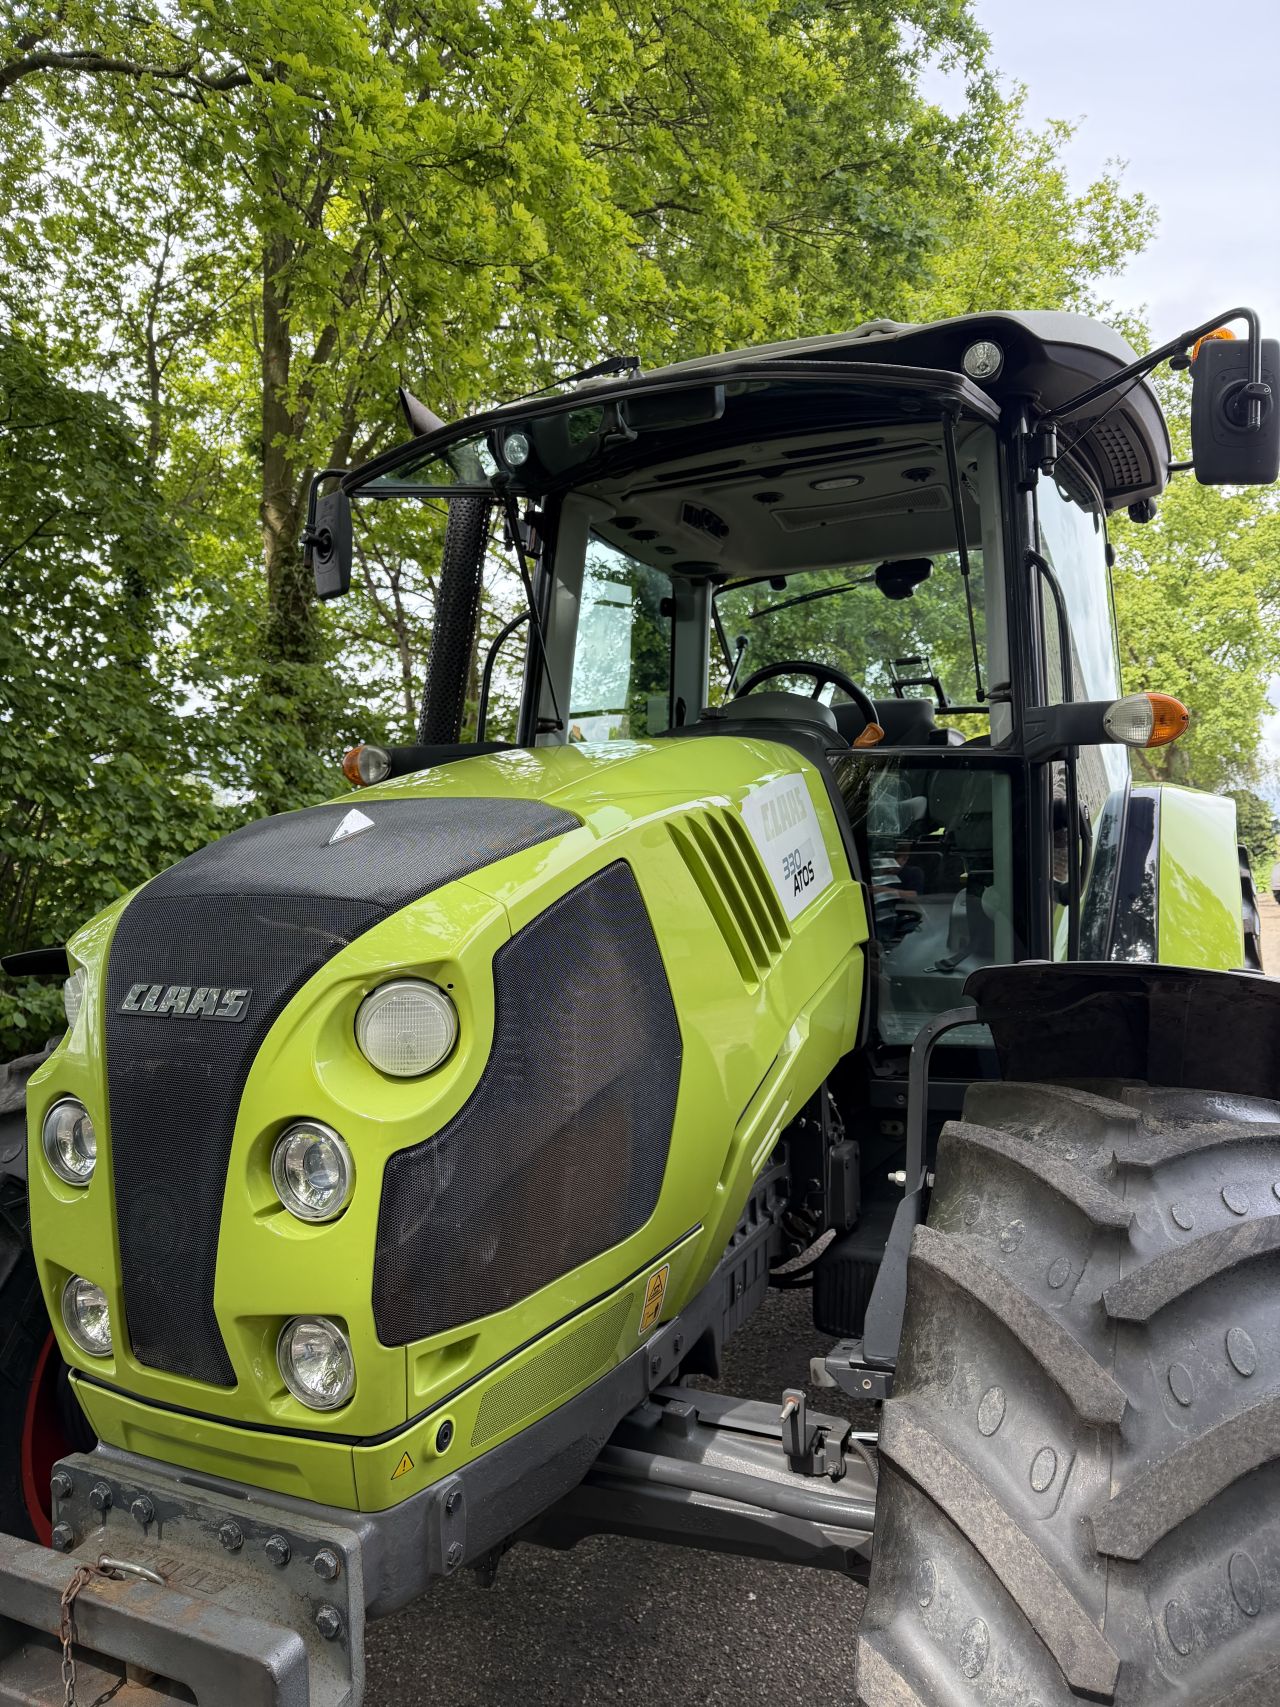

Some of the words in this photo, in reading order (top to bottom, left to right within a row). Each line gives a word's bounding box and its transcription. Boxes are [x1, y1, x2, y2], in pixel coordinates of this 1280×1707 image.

[760, 786, 808, 842] CLAAS
[782, 848, 802, 880] 330
[793, 860, 815, 897] ATOS
[121, 984, 249, 1017] CLAAS
